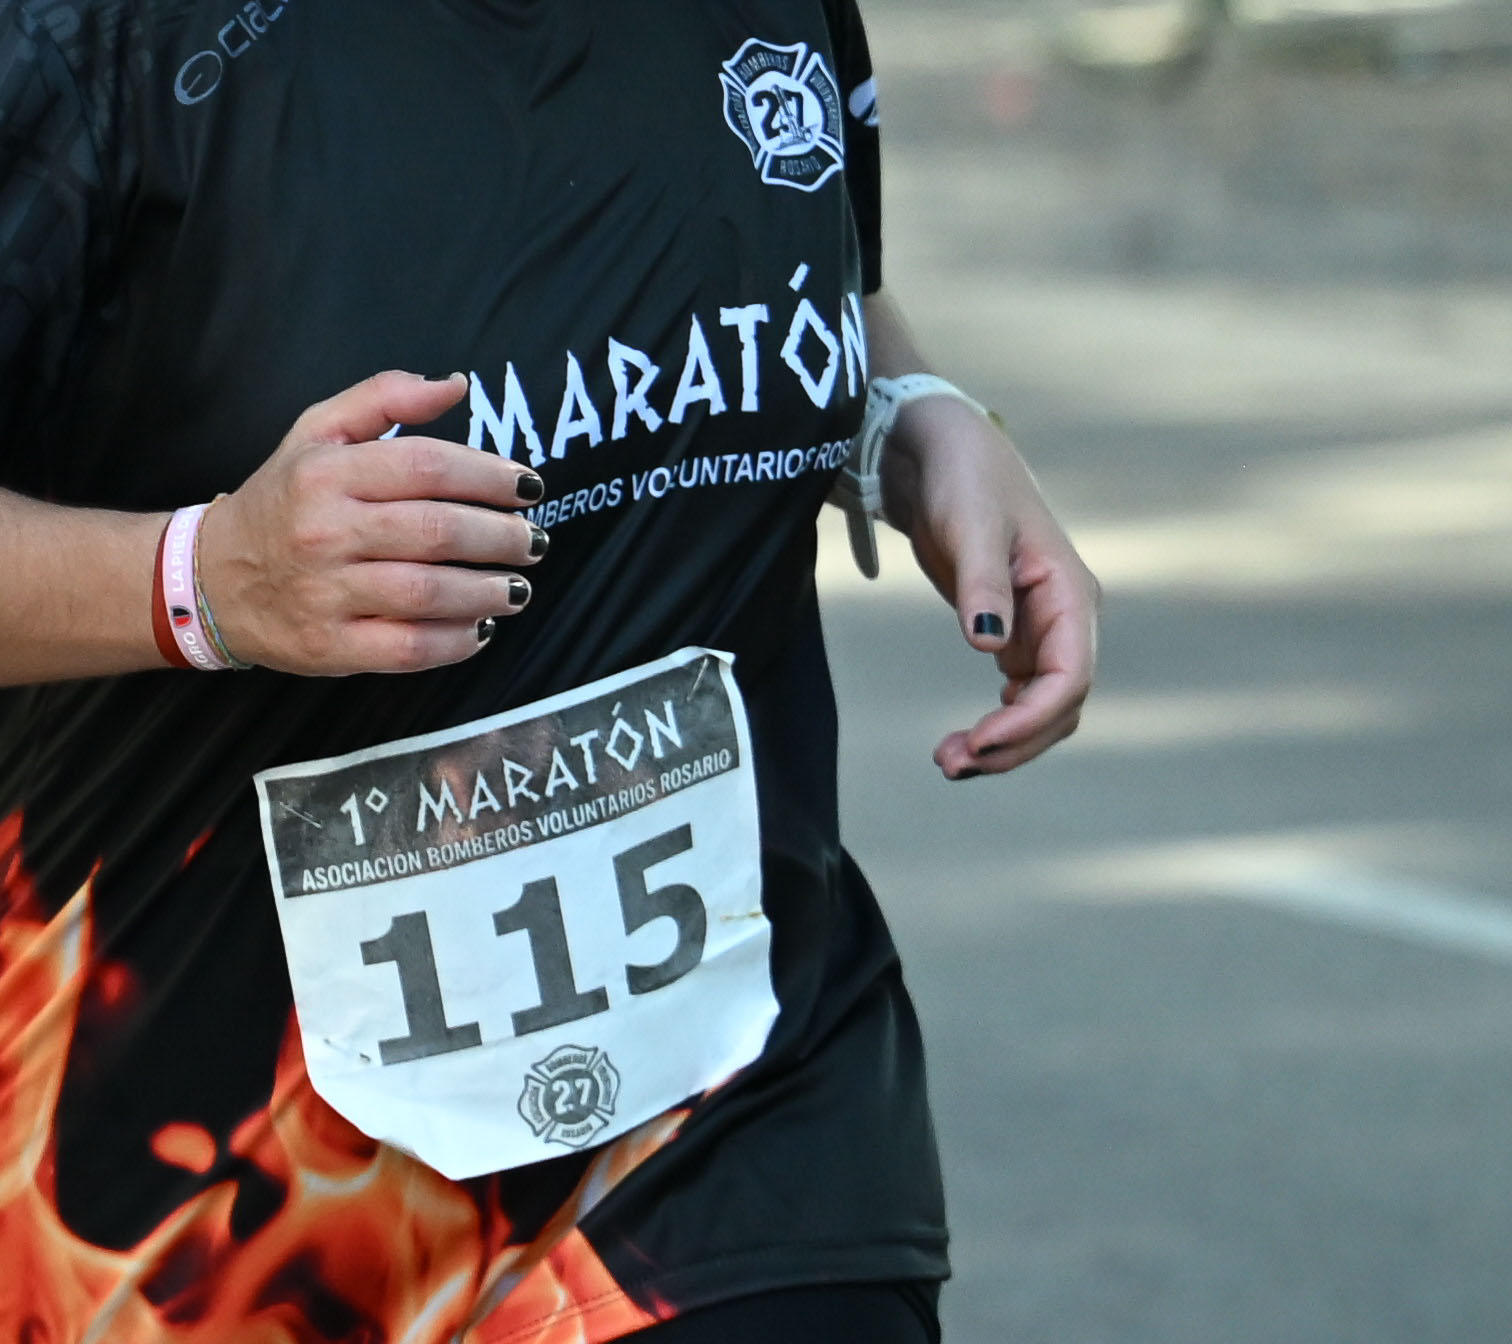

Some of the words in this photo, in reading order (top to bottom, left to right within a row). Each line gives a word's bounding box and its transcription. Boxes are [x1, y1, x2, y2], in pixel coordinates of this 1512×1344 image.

[467, 262, 867, 468] MARATÓN
[416, 700, 683, 833] MARATÓN
[427, 819, 534, 868] BOMBEROS
[536, 778, 657, 837] VOLUNTARIOS
[659, 748, 732, 795] ROSARIO
[358, 822, 708, 1066] 115
[551, 1077, 592, 1116] 27
